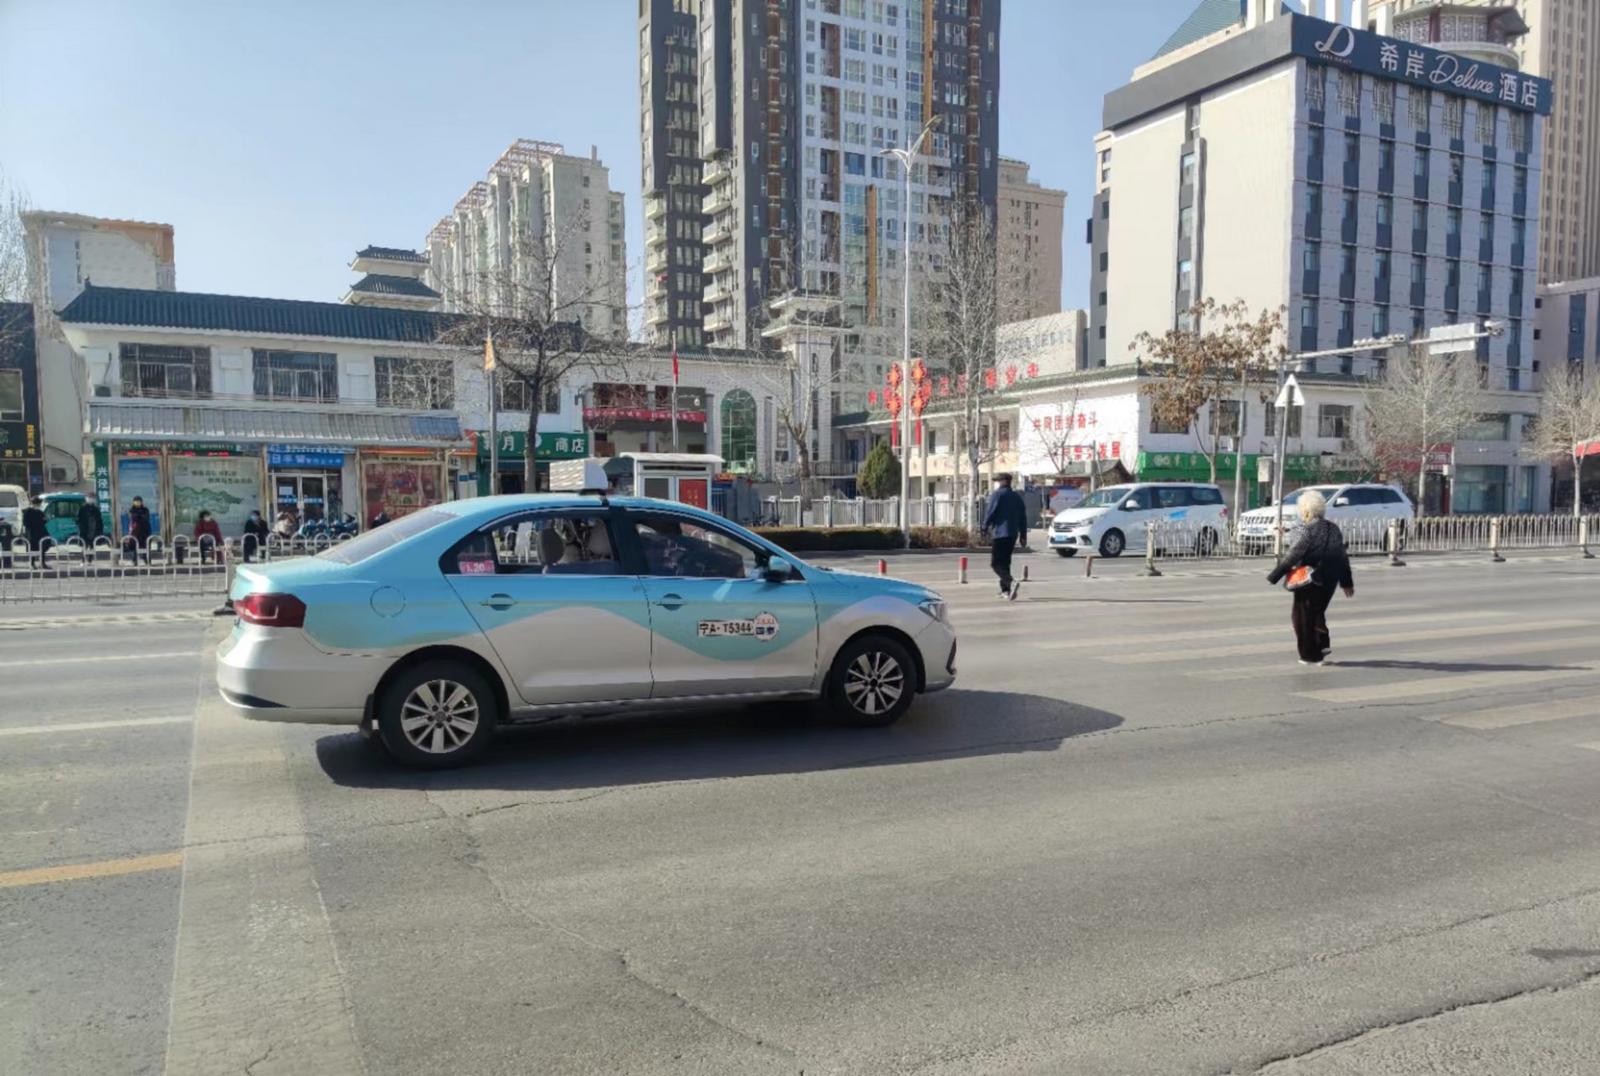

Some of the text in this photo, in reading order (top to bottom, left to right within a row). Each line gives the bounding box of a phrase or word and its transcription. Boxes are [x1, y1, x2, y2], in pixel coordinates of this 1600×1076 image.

[1314, 24, 1355, 57] D
[1380, 41, 1539, 108] 希岸 Deluxe 酒店
[555, 437, 585, 453] 商店
